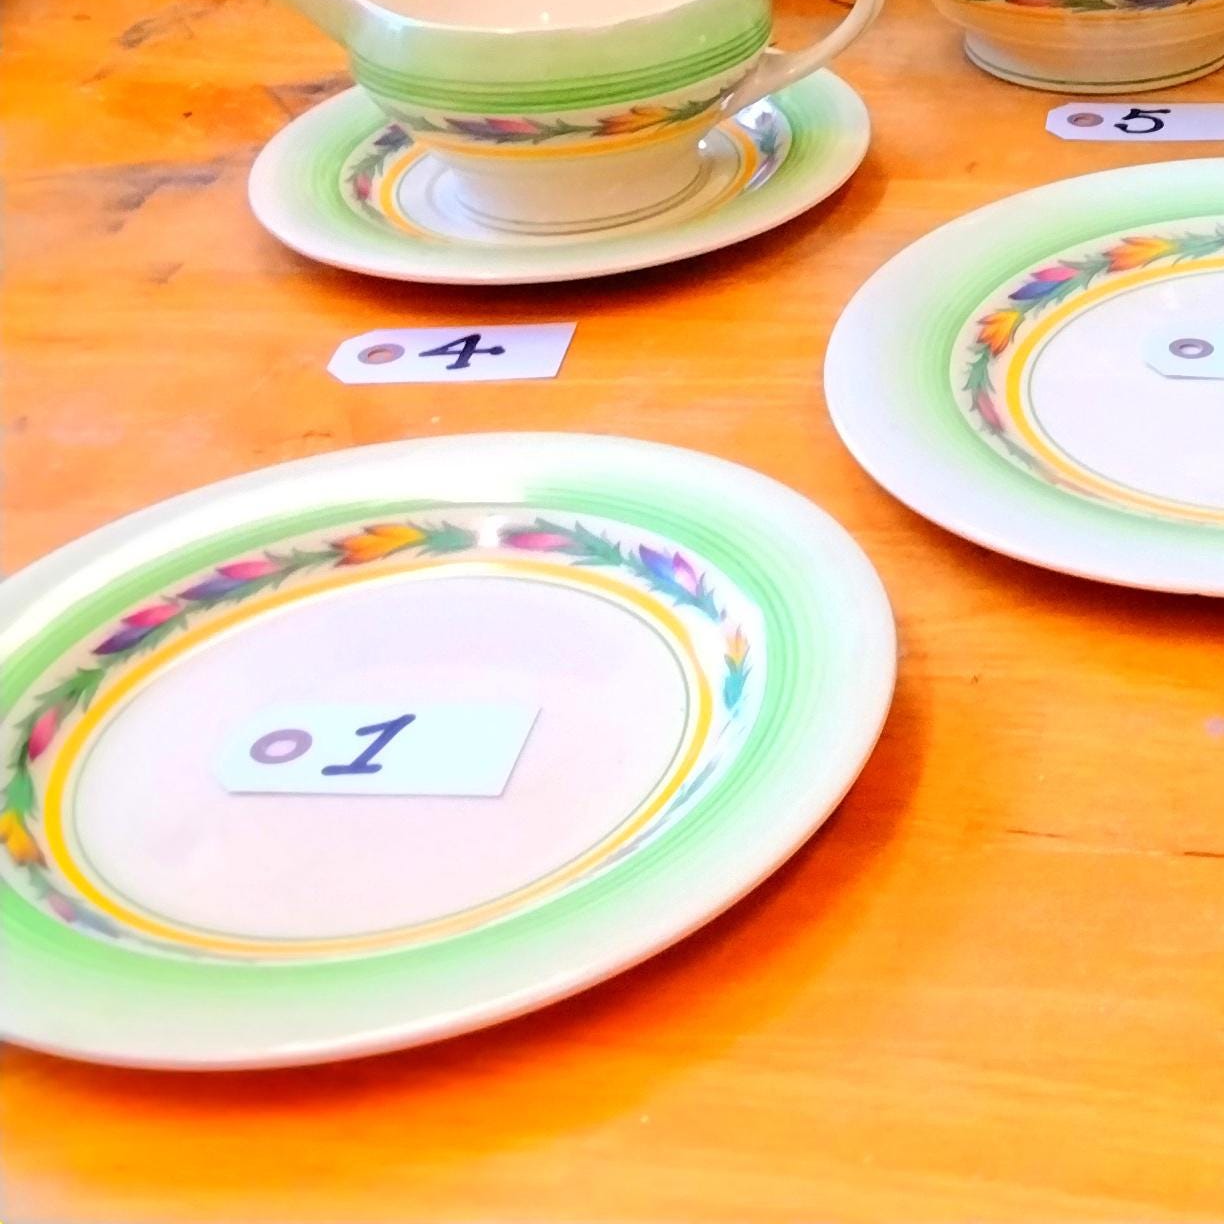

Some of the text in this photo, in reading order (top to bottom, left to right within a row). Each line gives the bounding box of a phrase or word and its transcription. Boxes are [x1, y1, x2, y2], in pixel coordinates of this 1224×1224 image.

[1113, 108, 1171, 134] 5
[418, 333, 505, 370] 4
[321, 713, 416, 776] 1
